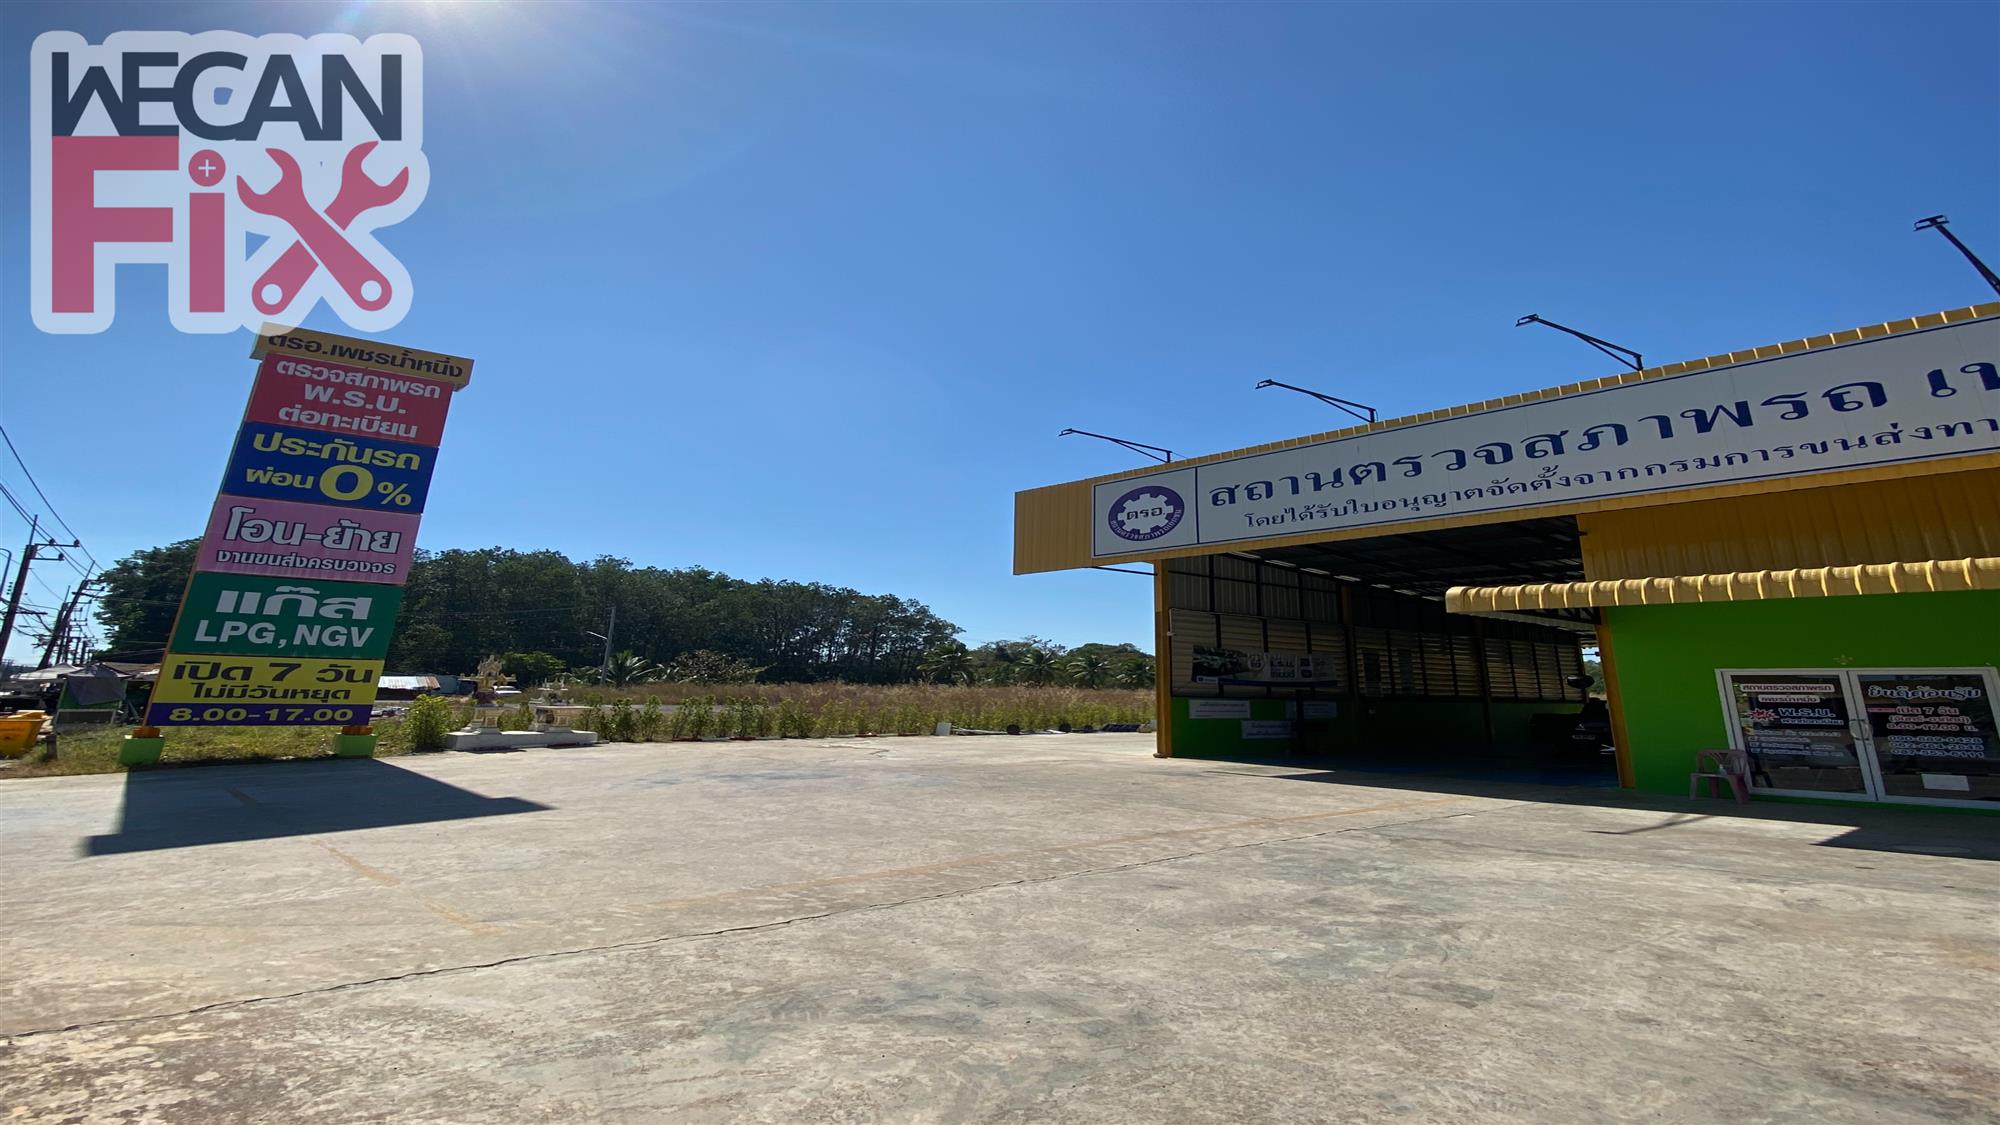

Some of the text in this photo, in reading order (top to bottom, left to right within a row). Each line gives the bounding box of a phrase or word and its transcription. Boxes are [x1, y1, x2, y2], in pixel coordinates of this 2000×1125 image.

[276, 361, 441, 399] ตรวจสภาพรถ
[304, 383, 406, 415] พ.ร.บ.
[279, 404, 417, 439] ต่อทะเบียน
[252, 432, 421, 471] ประกันรถ
[1209, 380, 1888, 507] สถานตรวจสภาพรถ
[246, 466, 314, 489] ผ่อน
[1126, 507, 1166, 521] ตรอ.
[224, 506, 402, 555] โอน-ย้าย
[216, 549, 395, 575] งานขนส่งครบวงจร
[215, 585, 375, 621] แก๊ส
[172, 661, 372, 684] เปิด 7 วัน
[191, 682, 351, 704] ไม่มีวันหยุด
[169, 707, 353, 722] 8.00-17.00
